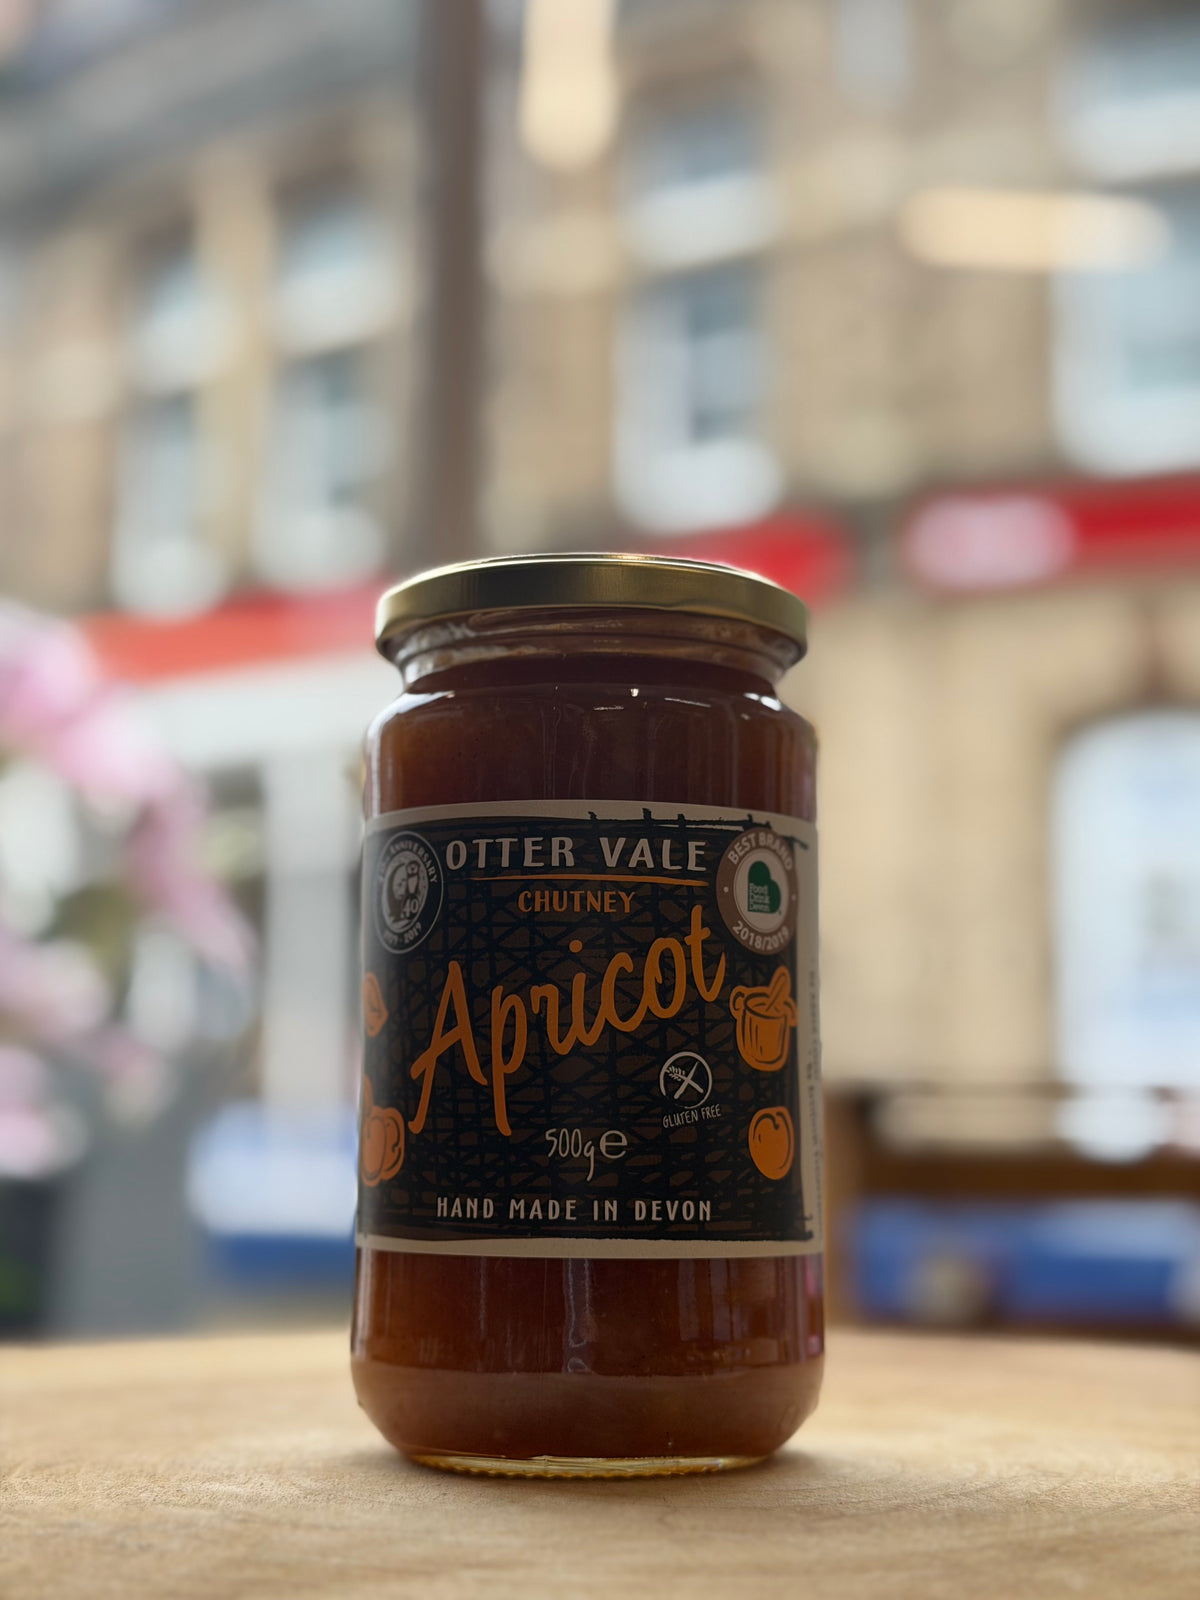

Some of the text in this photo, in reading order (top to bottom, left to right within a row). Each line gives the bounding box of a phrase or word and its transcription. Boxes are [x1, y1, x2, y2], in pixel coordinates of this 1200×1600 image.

[389, 840, 438, 884] ANNIVERSARY
[445, 836, 707, 872] OTTER VALE
[727, 832, 793, 871] BEST BRAND
[517, 890, 636, 913] CHUTNEY
[732, 920, 789, 951] 2018/2019
[407, 904, 726, 1137] Apricot
[662, 1103, 722, 1129] GLUTEN FREE
[436, 1197, 711, 1222] HAND MADE IN DEVON
